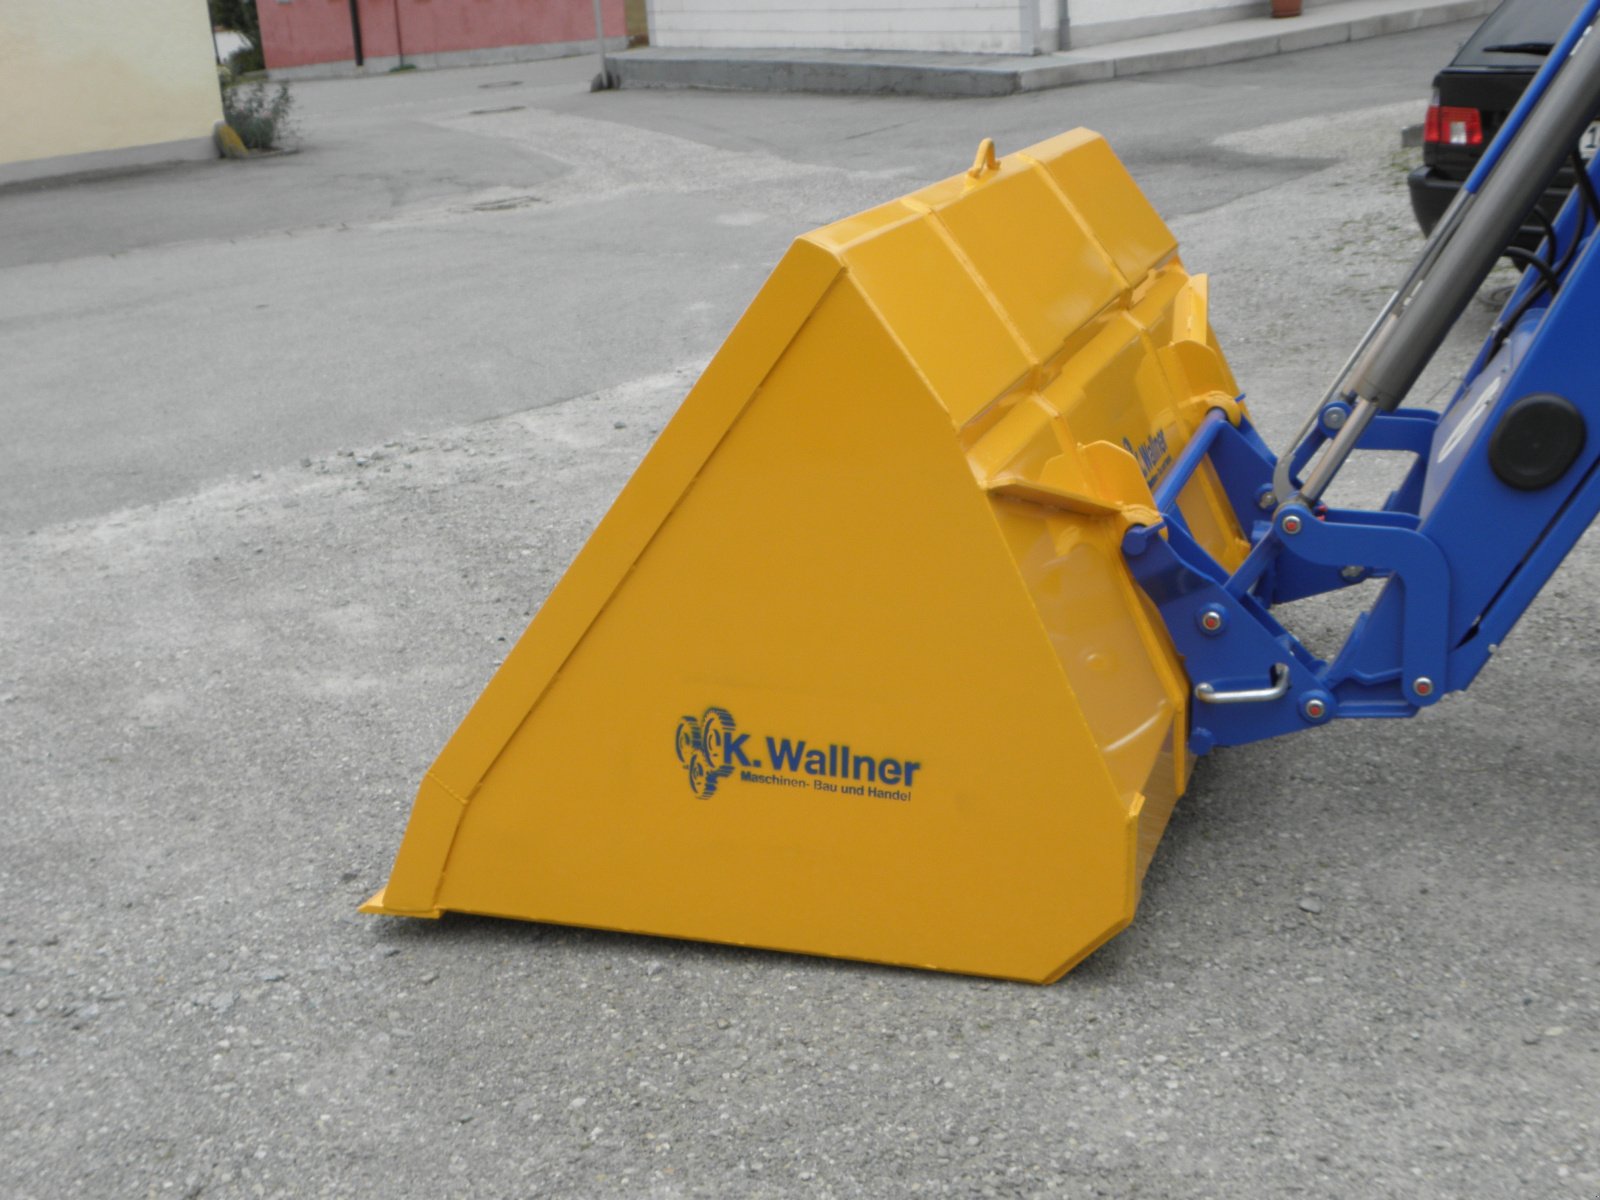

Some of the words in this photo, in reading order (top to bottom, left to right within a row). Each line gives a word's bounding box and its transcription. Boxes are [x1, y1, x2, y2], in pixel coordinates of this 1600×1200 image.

[724, 732, 761, 768] K.
[766, 736, 921, 786] Wallner
[741, 770, 810, 788] Maschinen-
[814, 780, 837, 793] Bau
[841, 785, 864, 796] und
[868, 788, 911, 801] Handel
